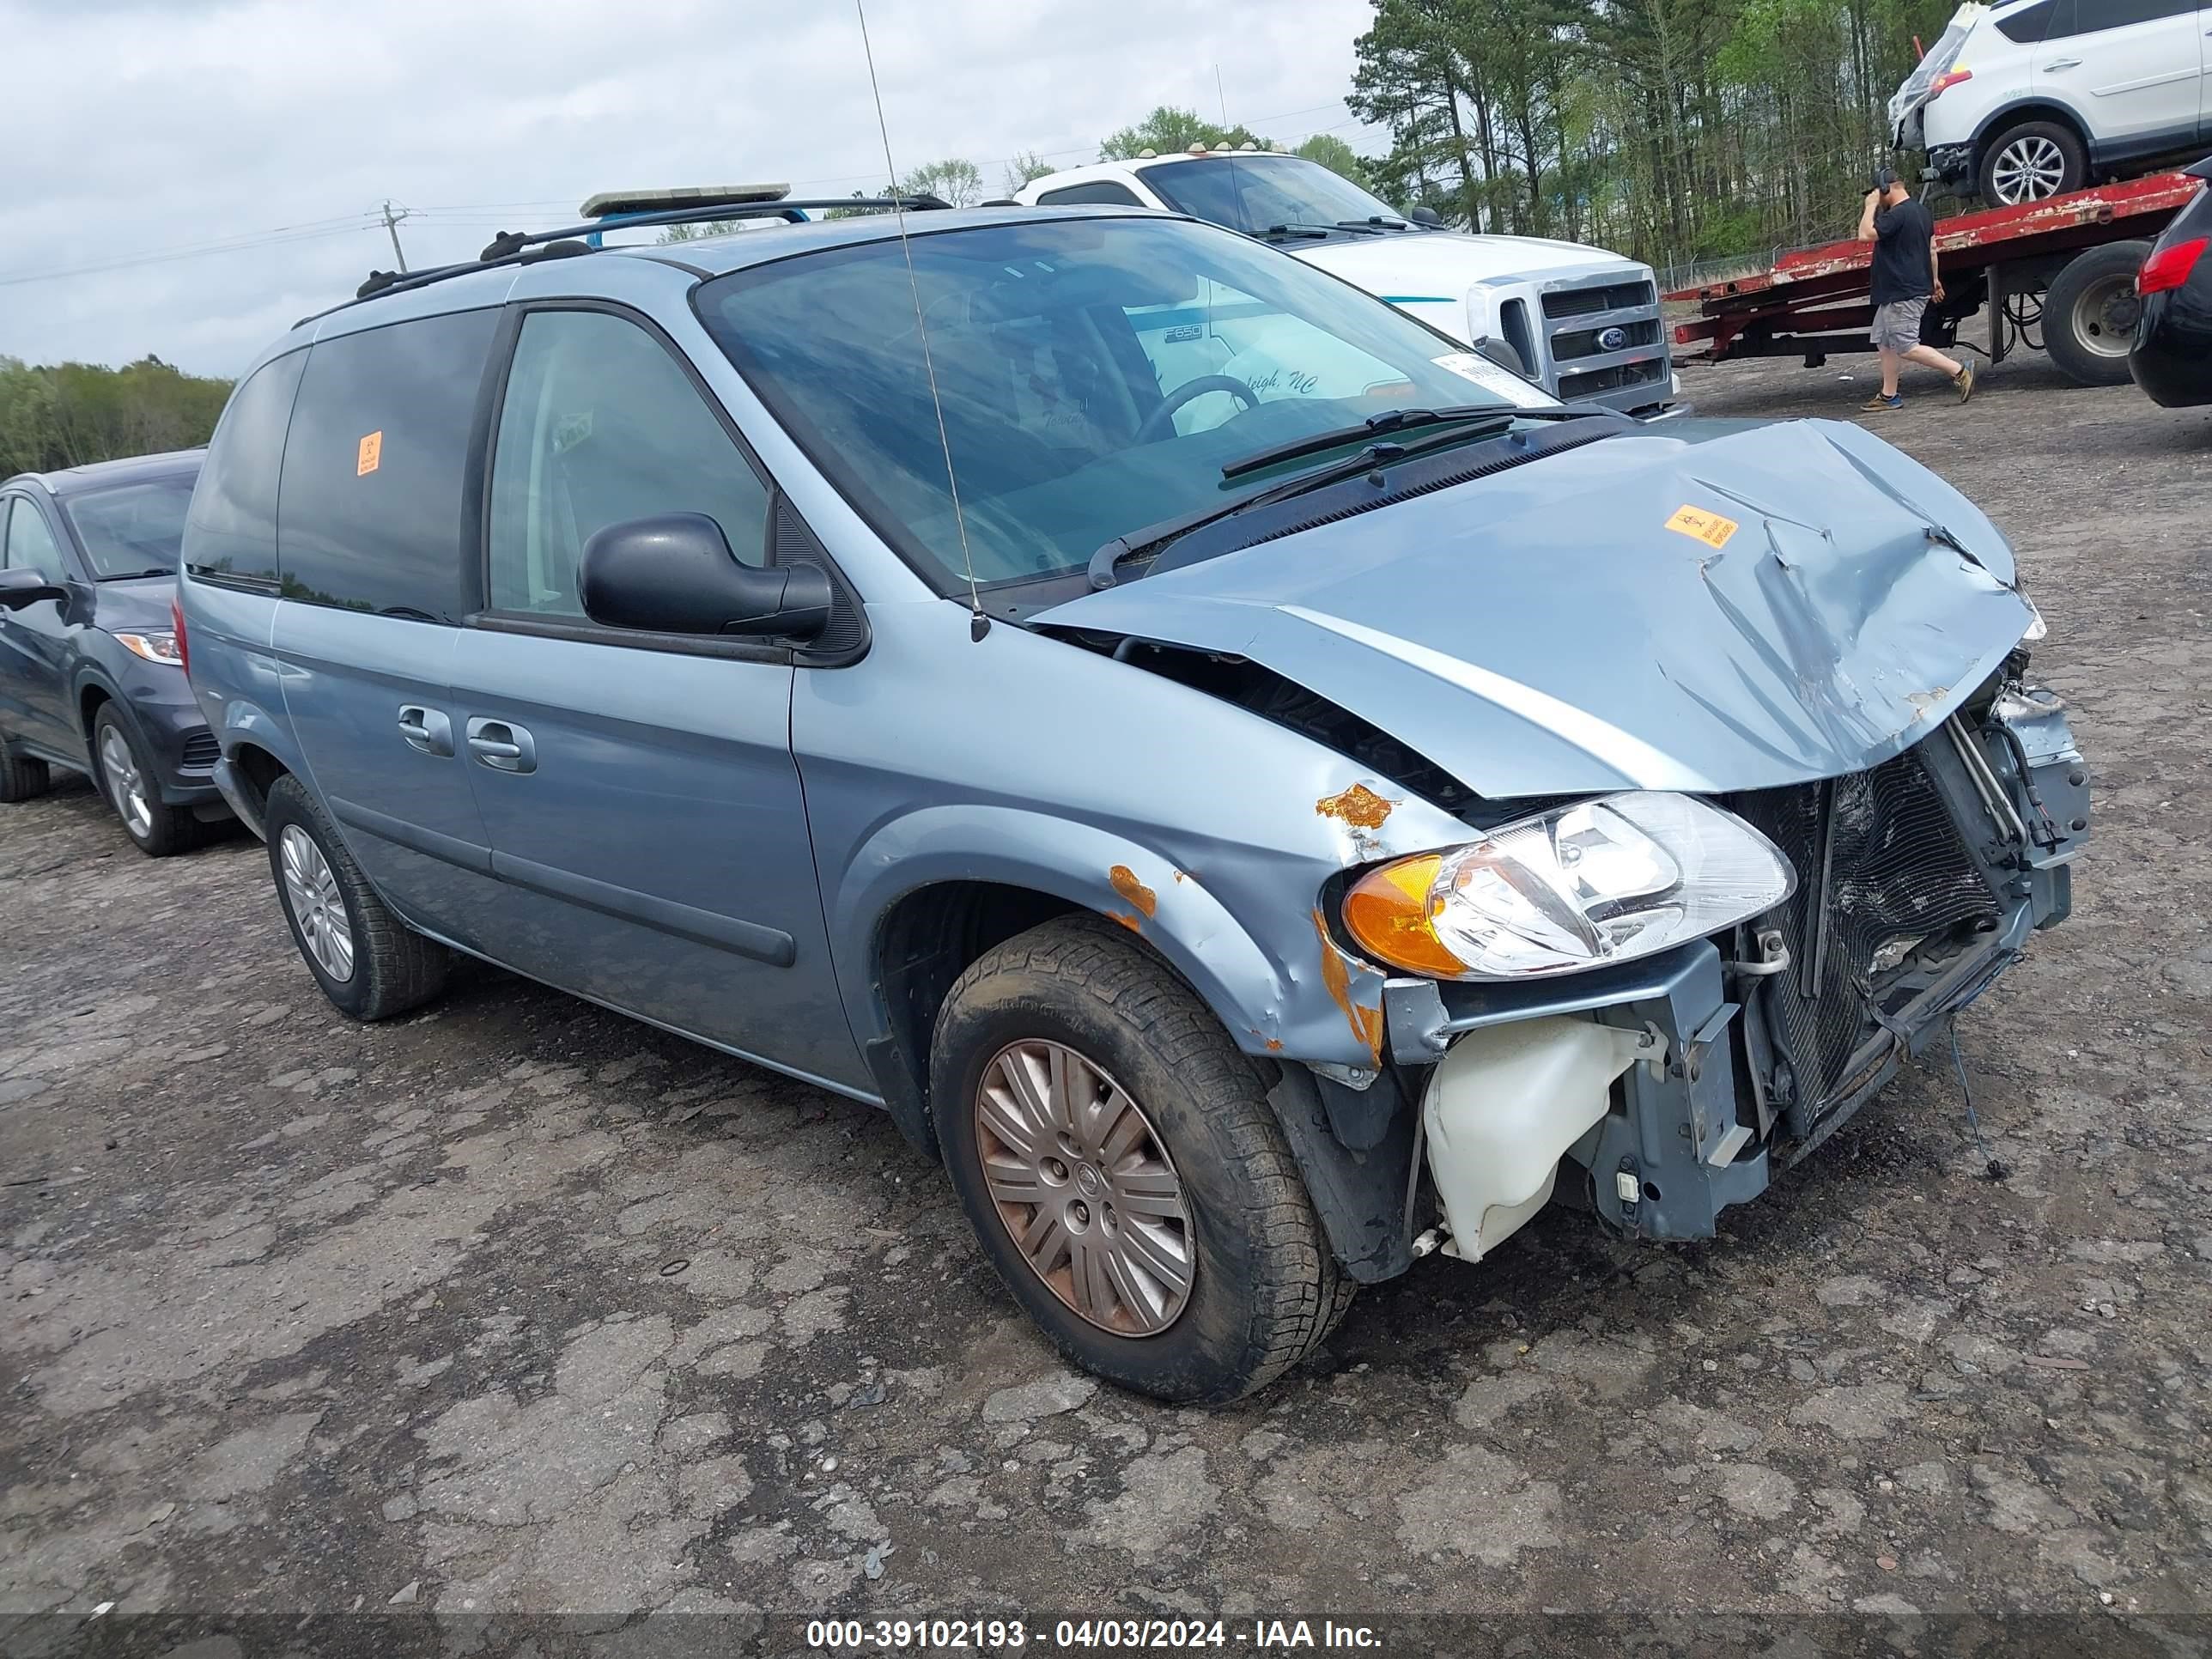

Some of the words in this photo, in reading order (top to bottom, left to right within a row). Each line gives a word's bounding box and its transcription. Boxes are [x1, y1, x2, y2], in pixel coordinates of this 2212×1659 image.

[1164, 325, 1201, 339] F650
[1606, 331, 1623, 345] Ford
[1289, 370, 1319, 394] NC
